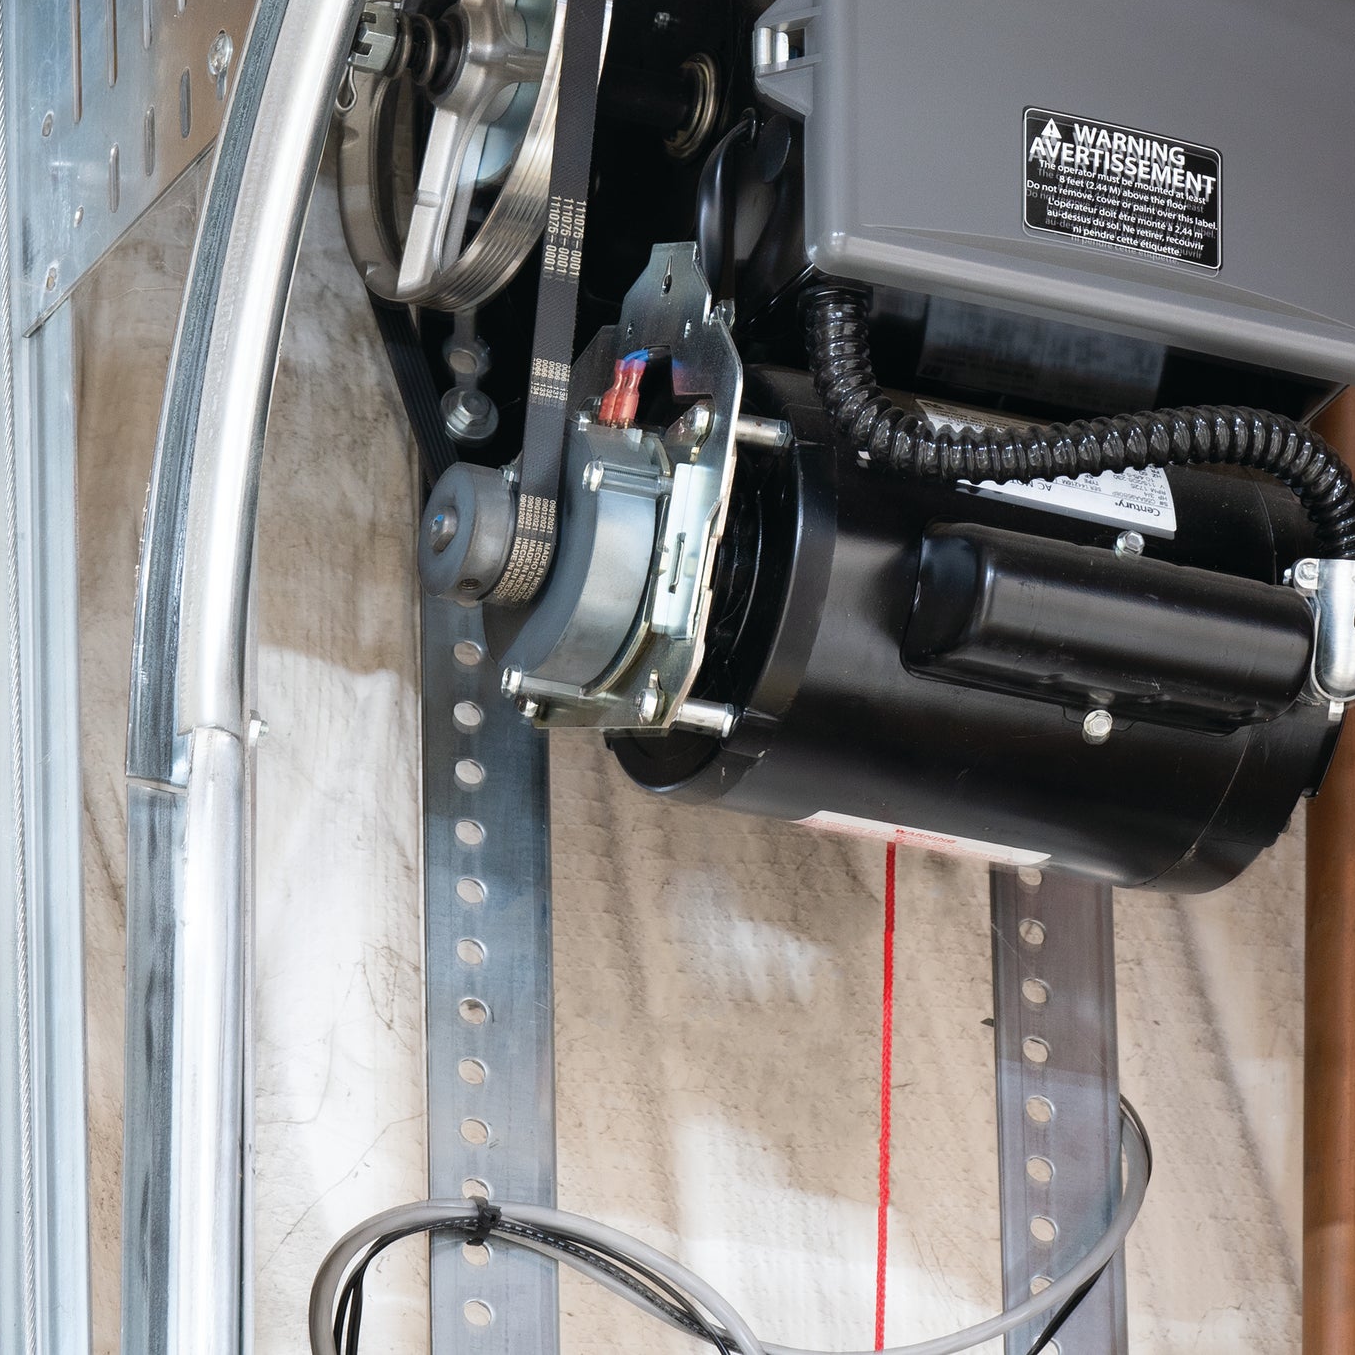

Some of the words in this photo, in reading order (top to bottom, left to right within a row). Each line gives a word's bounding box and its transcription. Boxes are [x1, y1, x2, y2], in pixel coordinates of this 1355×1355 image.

[1074, 122, 1185, 166] WARNING
[1029, 136, 1216, 194] AVERTISSEMENT
[1039, 159, 1056, 170] The
[1058, 164, 1097, 178] operator
[1098, 172, 1120, 184] must
[1122, 177, 1133, 187] be
[1135, 180, 1173, 195] mounted
[1176, 189, 1185, 198] at
[1186, 191, 1206, 205] least
[1066, 176, 1084, 188] feet
[1086, 179, 1107, 192] (2.44
[1109, 184, 1121, 196] M)
[1123, 189, 1149, 203] above
[1151, 194, 1165, 206] the
[1167, 196, 1187, 211] floor
[1027, 180, 1040, 189] Do
[1042, 183, 1057, 193] not
[1059, 188, 1095, 202] remove,
[1096, 195, 1120, 206] cover
[1122, 200, 1132, 209] or
[1133, 202, 1155, 216] paint
[1157, 208, 1176, 220] over
[1178, 210, 1193, 223] this
[1195, 214, 1217, 230] label.
[1048, 197, 1097, 216] L'opérateur
[1099, 206, 1116, 219] doit
[1138, 214, 1166, 230] monté
[1047, 209, 1091, 225] au-dessus
[1093, 216, 1105, 227] du
[1107, 219, 1121, 231] sol.
[1123, 224, 1135, 235] Ne
[1137, 228, 1164, 242] retirer,
[1166, 235, 1205, 251] recouvrir
[1072, 225, 1082, 233] ni
[1083, 227, 1115, 242] pendre
[1117, 234, 1139, 246] cette
[1140, 239, 1182, 256] étiquette.
[1037, 482, 1052, 492] AC
[1118, 499, 1160, 517] Century
[510, 537, 522, 561] MADE
[516, 538, 529, 567] HECHO
[524, 540, 536, 564] MADE
[532, 541, 544, 570] HECHO
[540, 543, 551, 566] MADE
